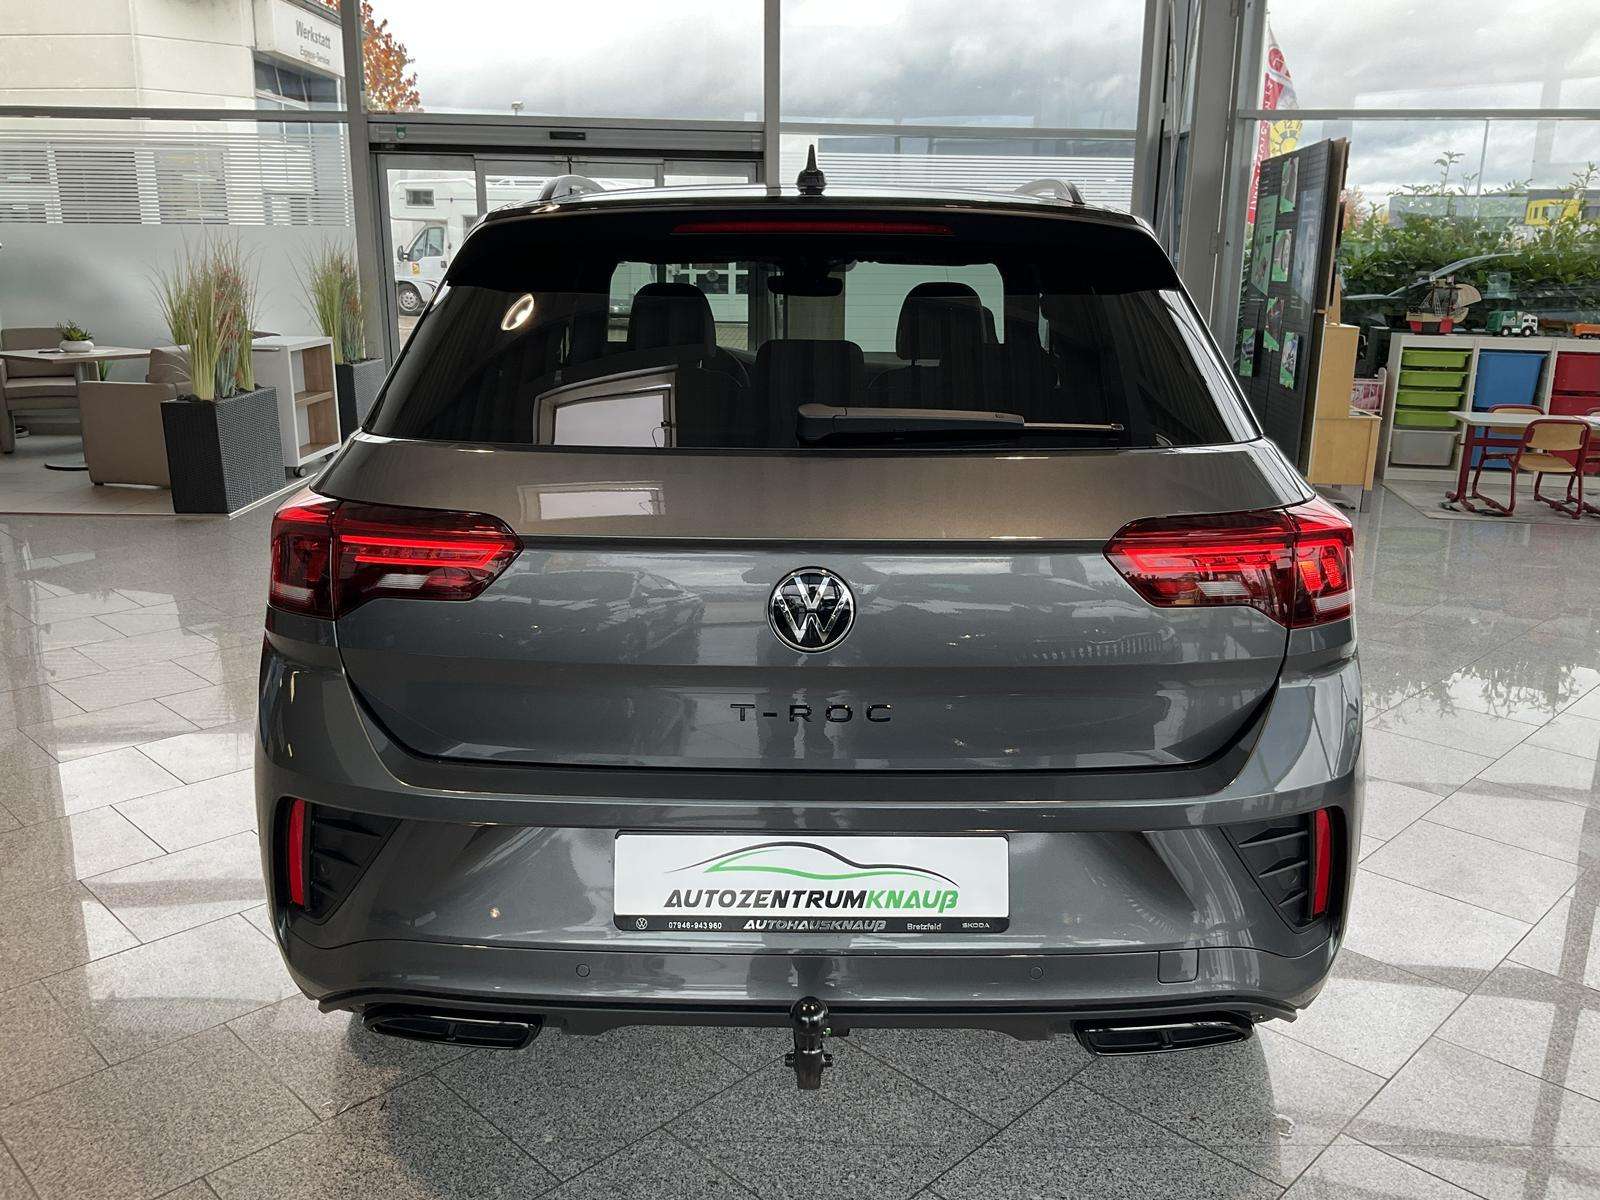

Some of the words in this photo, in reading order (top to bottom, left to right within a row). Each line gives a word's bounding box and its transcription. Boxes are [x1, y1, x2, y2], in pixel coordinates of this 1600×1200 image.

[296, 19, 331, 49] Werkstatt
[730, 703, 893, 723] T-ROC
[906, 922, 942, 932] Bretzfeld
